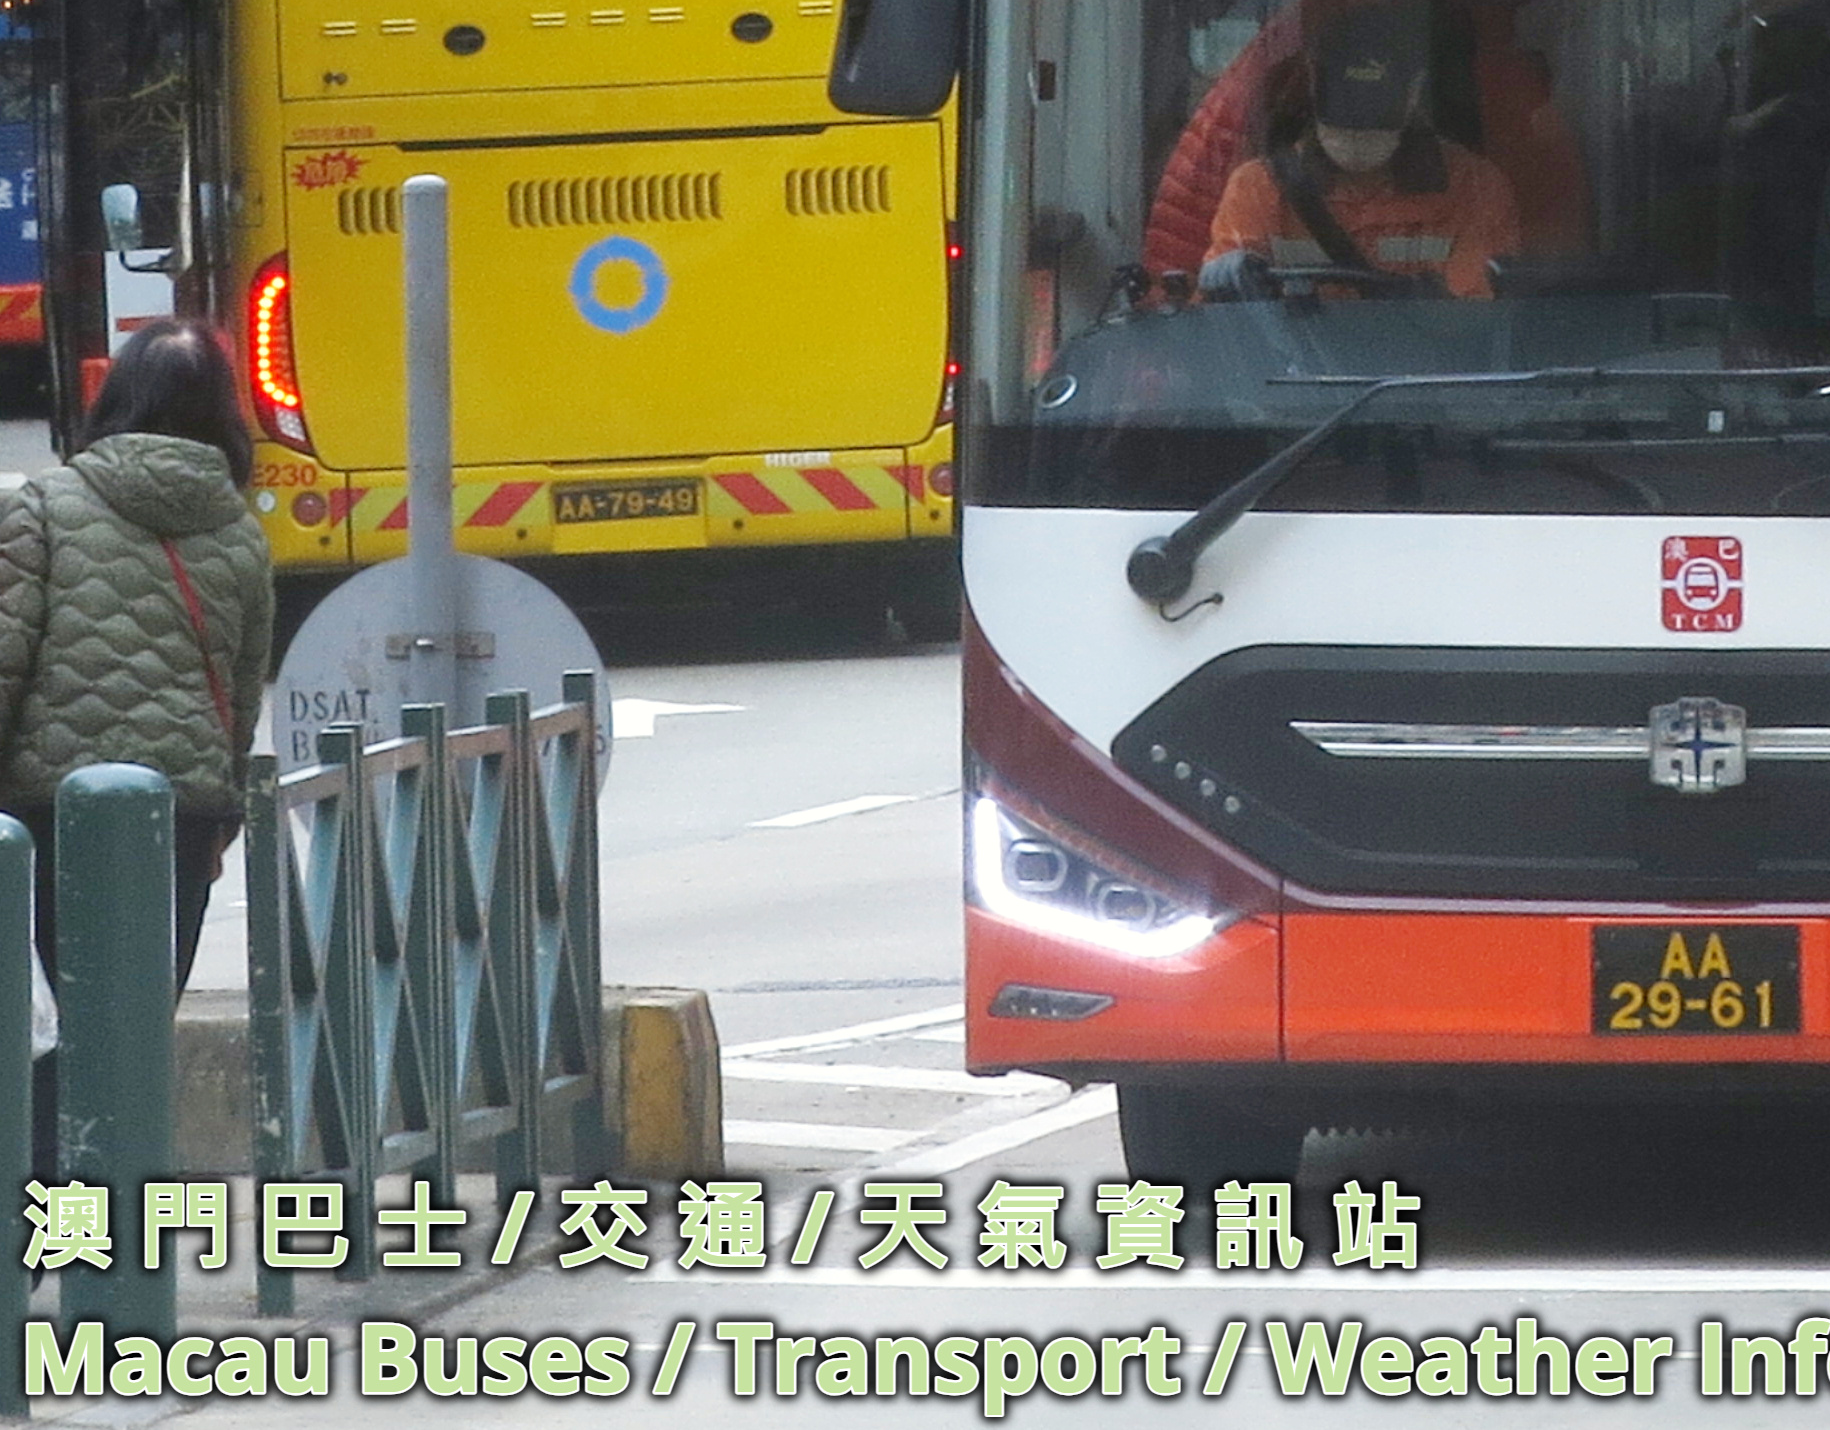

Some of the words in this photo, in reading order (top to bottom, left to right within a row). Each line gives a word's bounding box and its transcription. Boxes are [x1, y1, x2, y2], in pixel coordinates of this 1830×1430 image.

[559, 487, 695, 520] AA-79-49
[1661, 931, 1731, 979] AA
[1610, 980, 1773, 1030] 29-61
